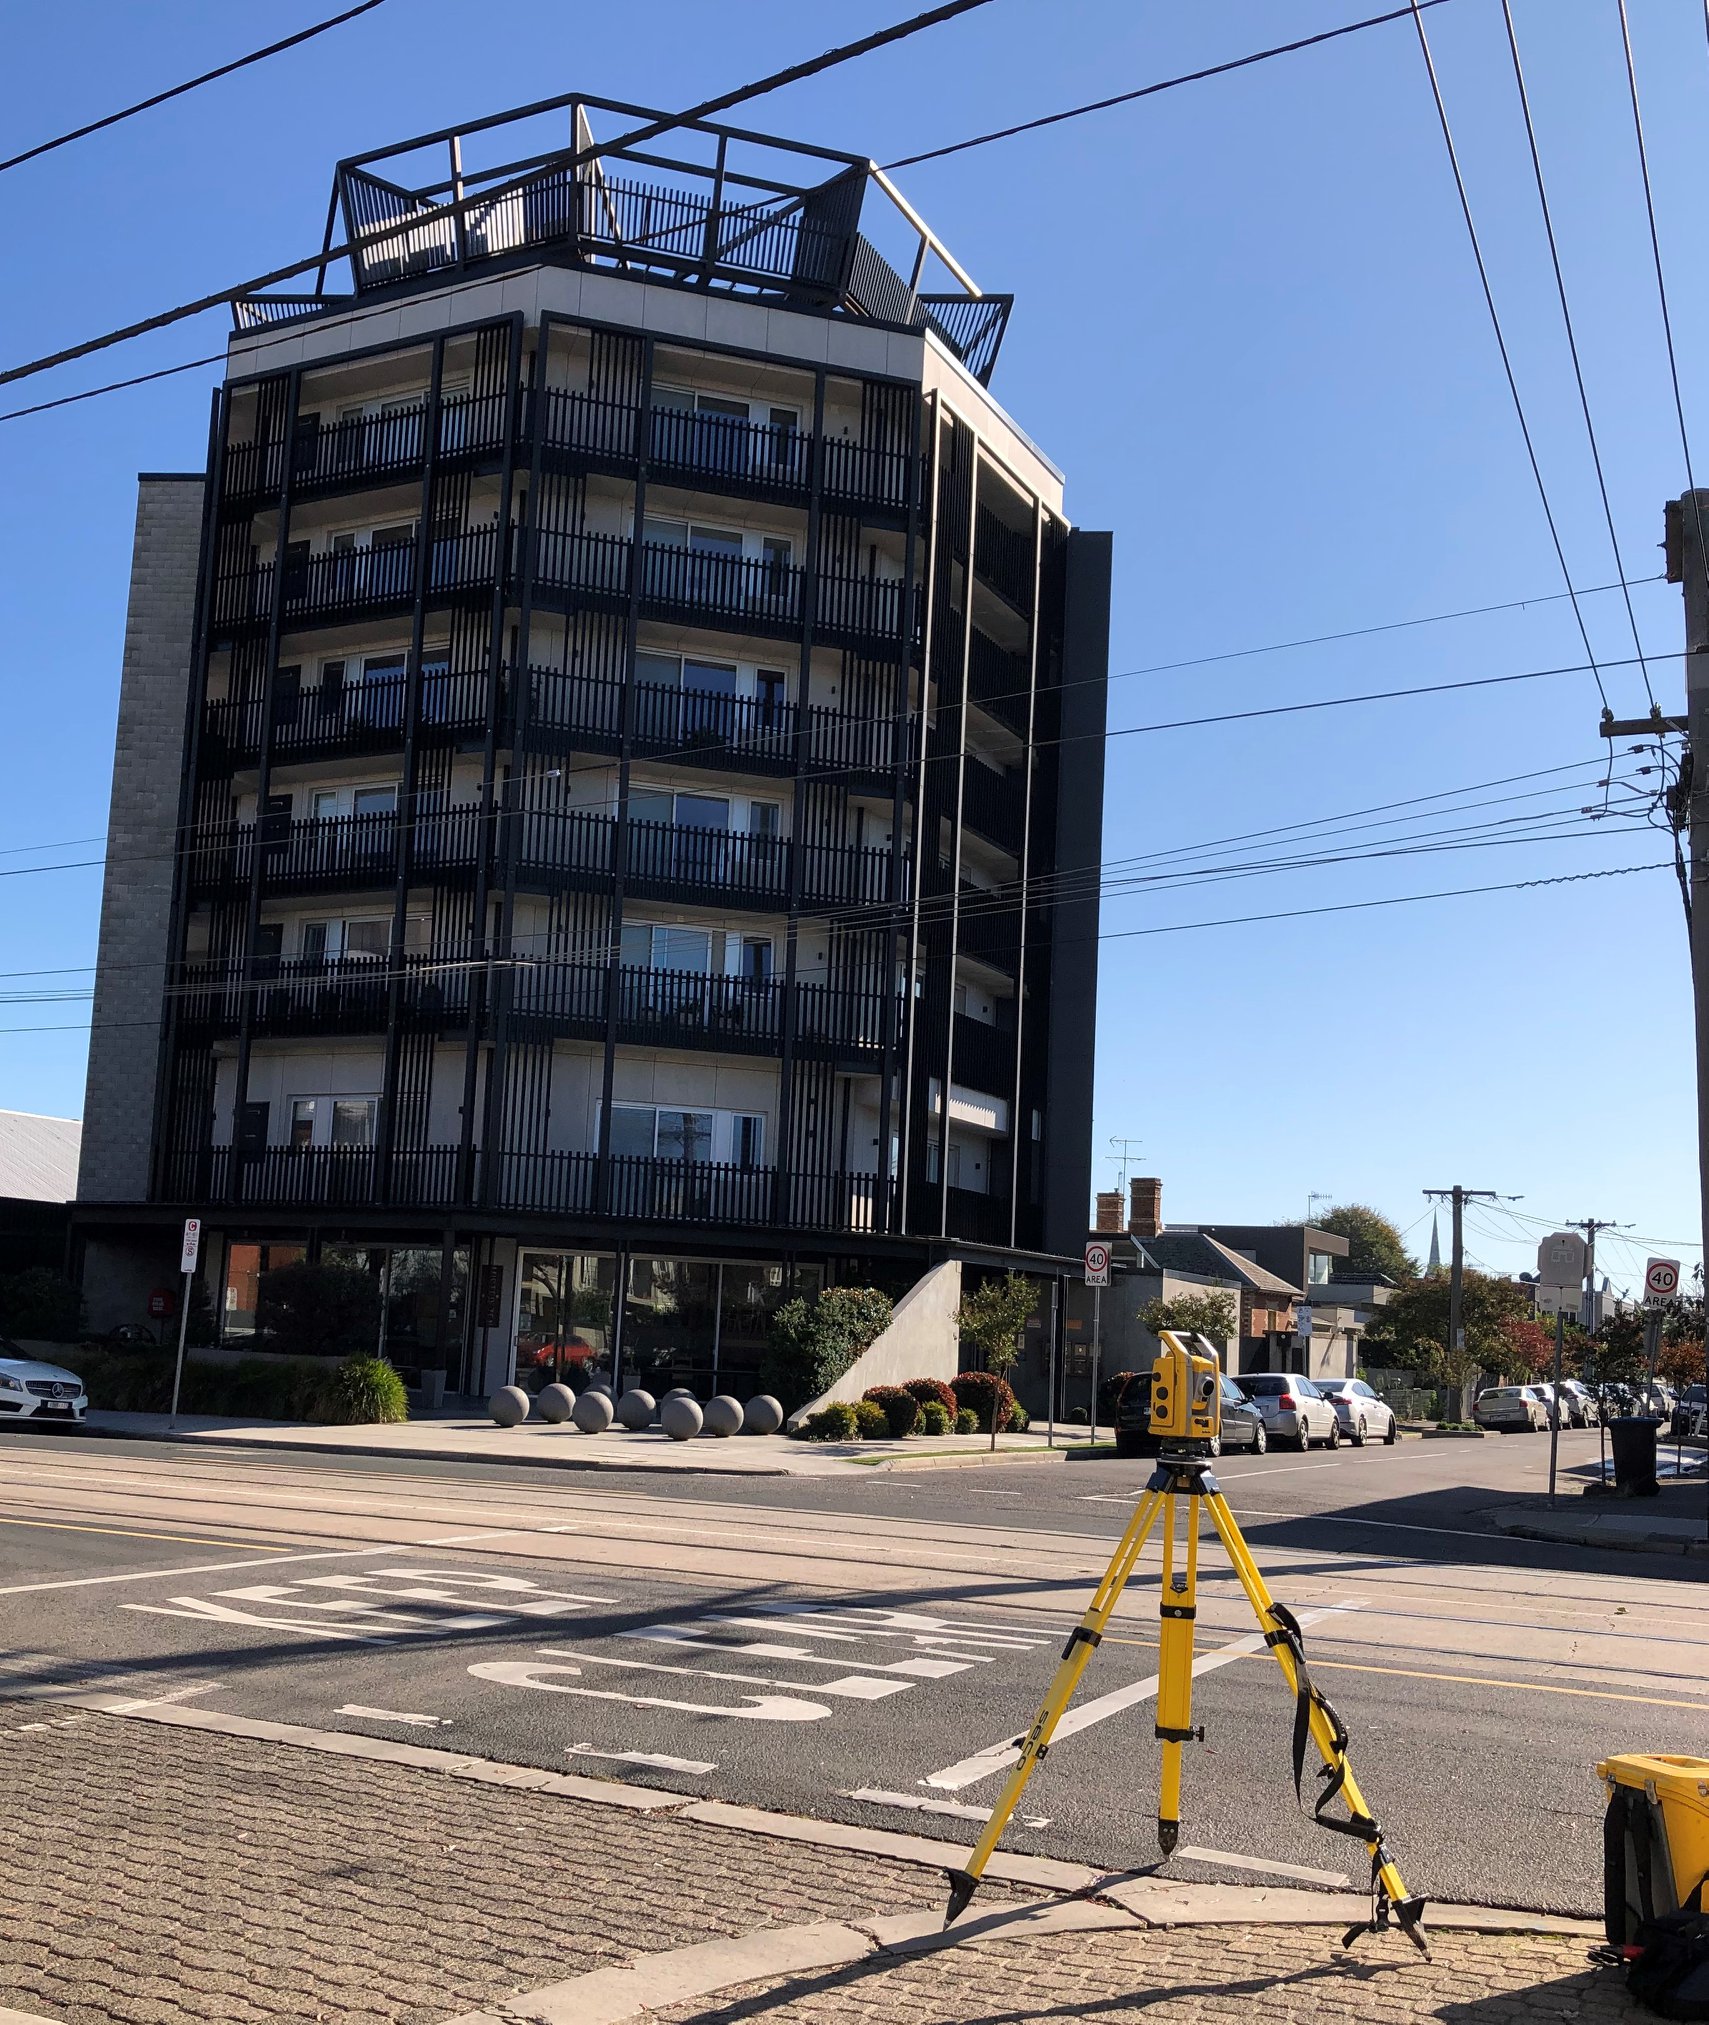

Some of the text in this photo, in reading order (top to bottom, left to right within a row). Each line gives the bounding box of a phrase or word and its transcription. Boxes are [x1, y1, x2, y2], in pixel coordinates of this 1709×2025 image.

[1090, 1253, 1104, 1265] 40
[1086, 1275, 1107, 1284] AREA
[1651, 1271, 1673, 1286] 40
[1644, 1295, 1675, 1308] AREA
[117, 1568, 621, 1646] KEEP
[467, 1603, 1076, 1722] CLEAR
